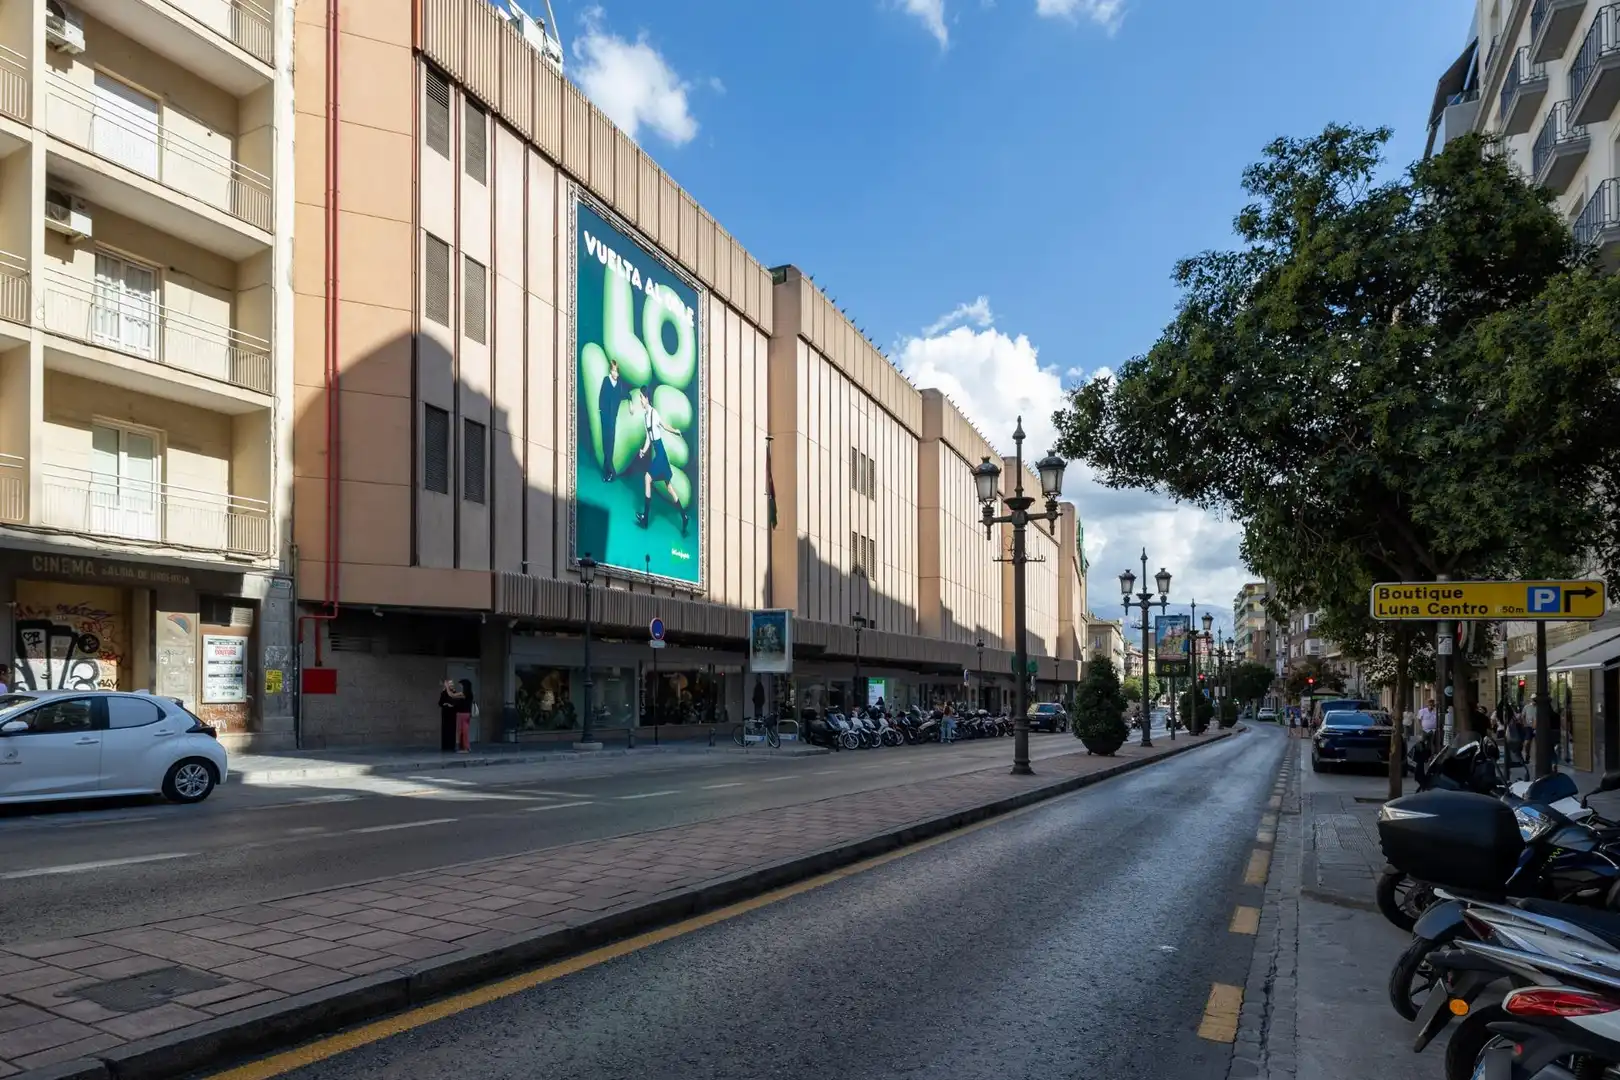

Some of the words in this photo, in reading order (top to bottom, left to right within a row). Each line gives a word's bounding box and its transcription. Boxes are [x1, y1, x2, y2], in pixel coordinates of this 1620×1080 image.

[584, 230, 642, 290] VUELTA
[645, 277, 660, 304] AL
[32, 556, 96, 576] CINEMA
[137, 569, 148, 580] DE
[1379, 587, 1464, 602] Boutique
[1534, 589, 1556, 611] P
[1379, 603, 1419, 615] Luna
[1428, 602, 1488, 615] Centro
